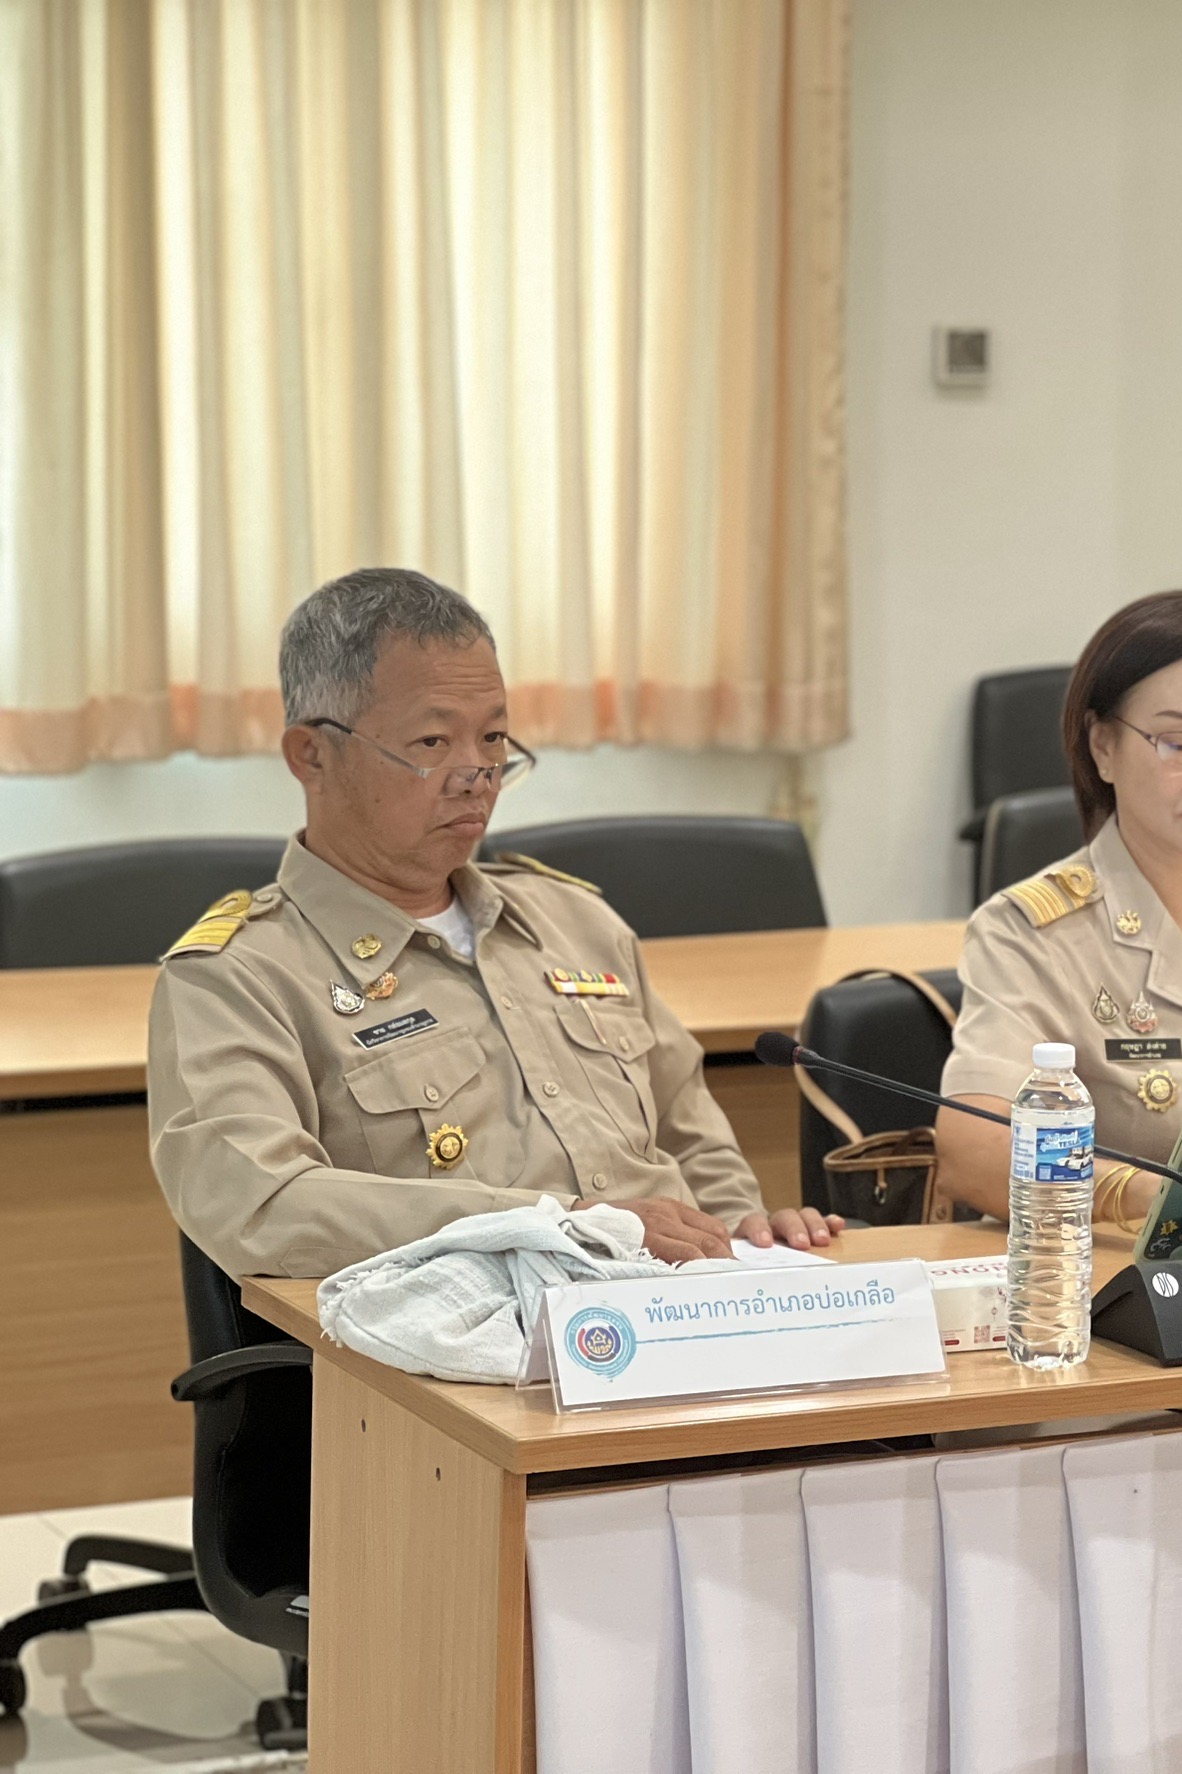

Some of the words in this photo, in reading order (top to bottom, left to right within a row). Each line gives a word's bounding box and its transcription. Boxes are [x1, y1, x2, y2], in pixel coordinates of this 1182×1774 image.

[1059, 1139, 1080, 1148] TESLA
[644, 1279, 895, 1323] พัฒนาการอำเภอบ่อเกลือ
